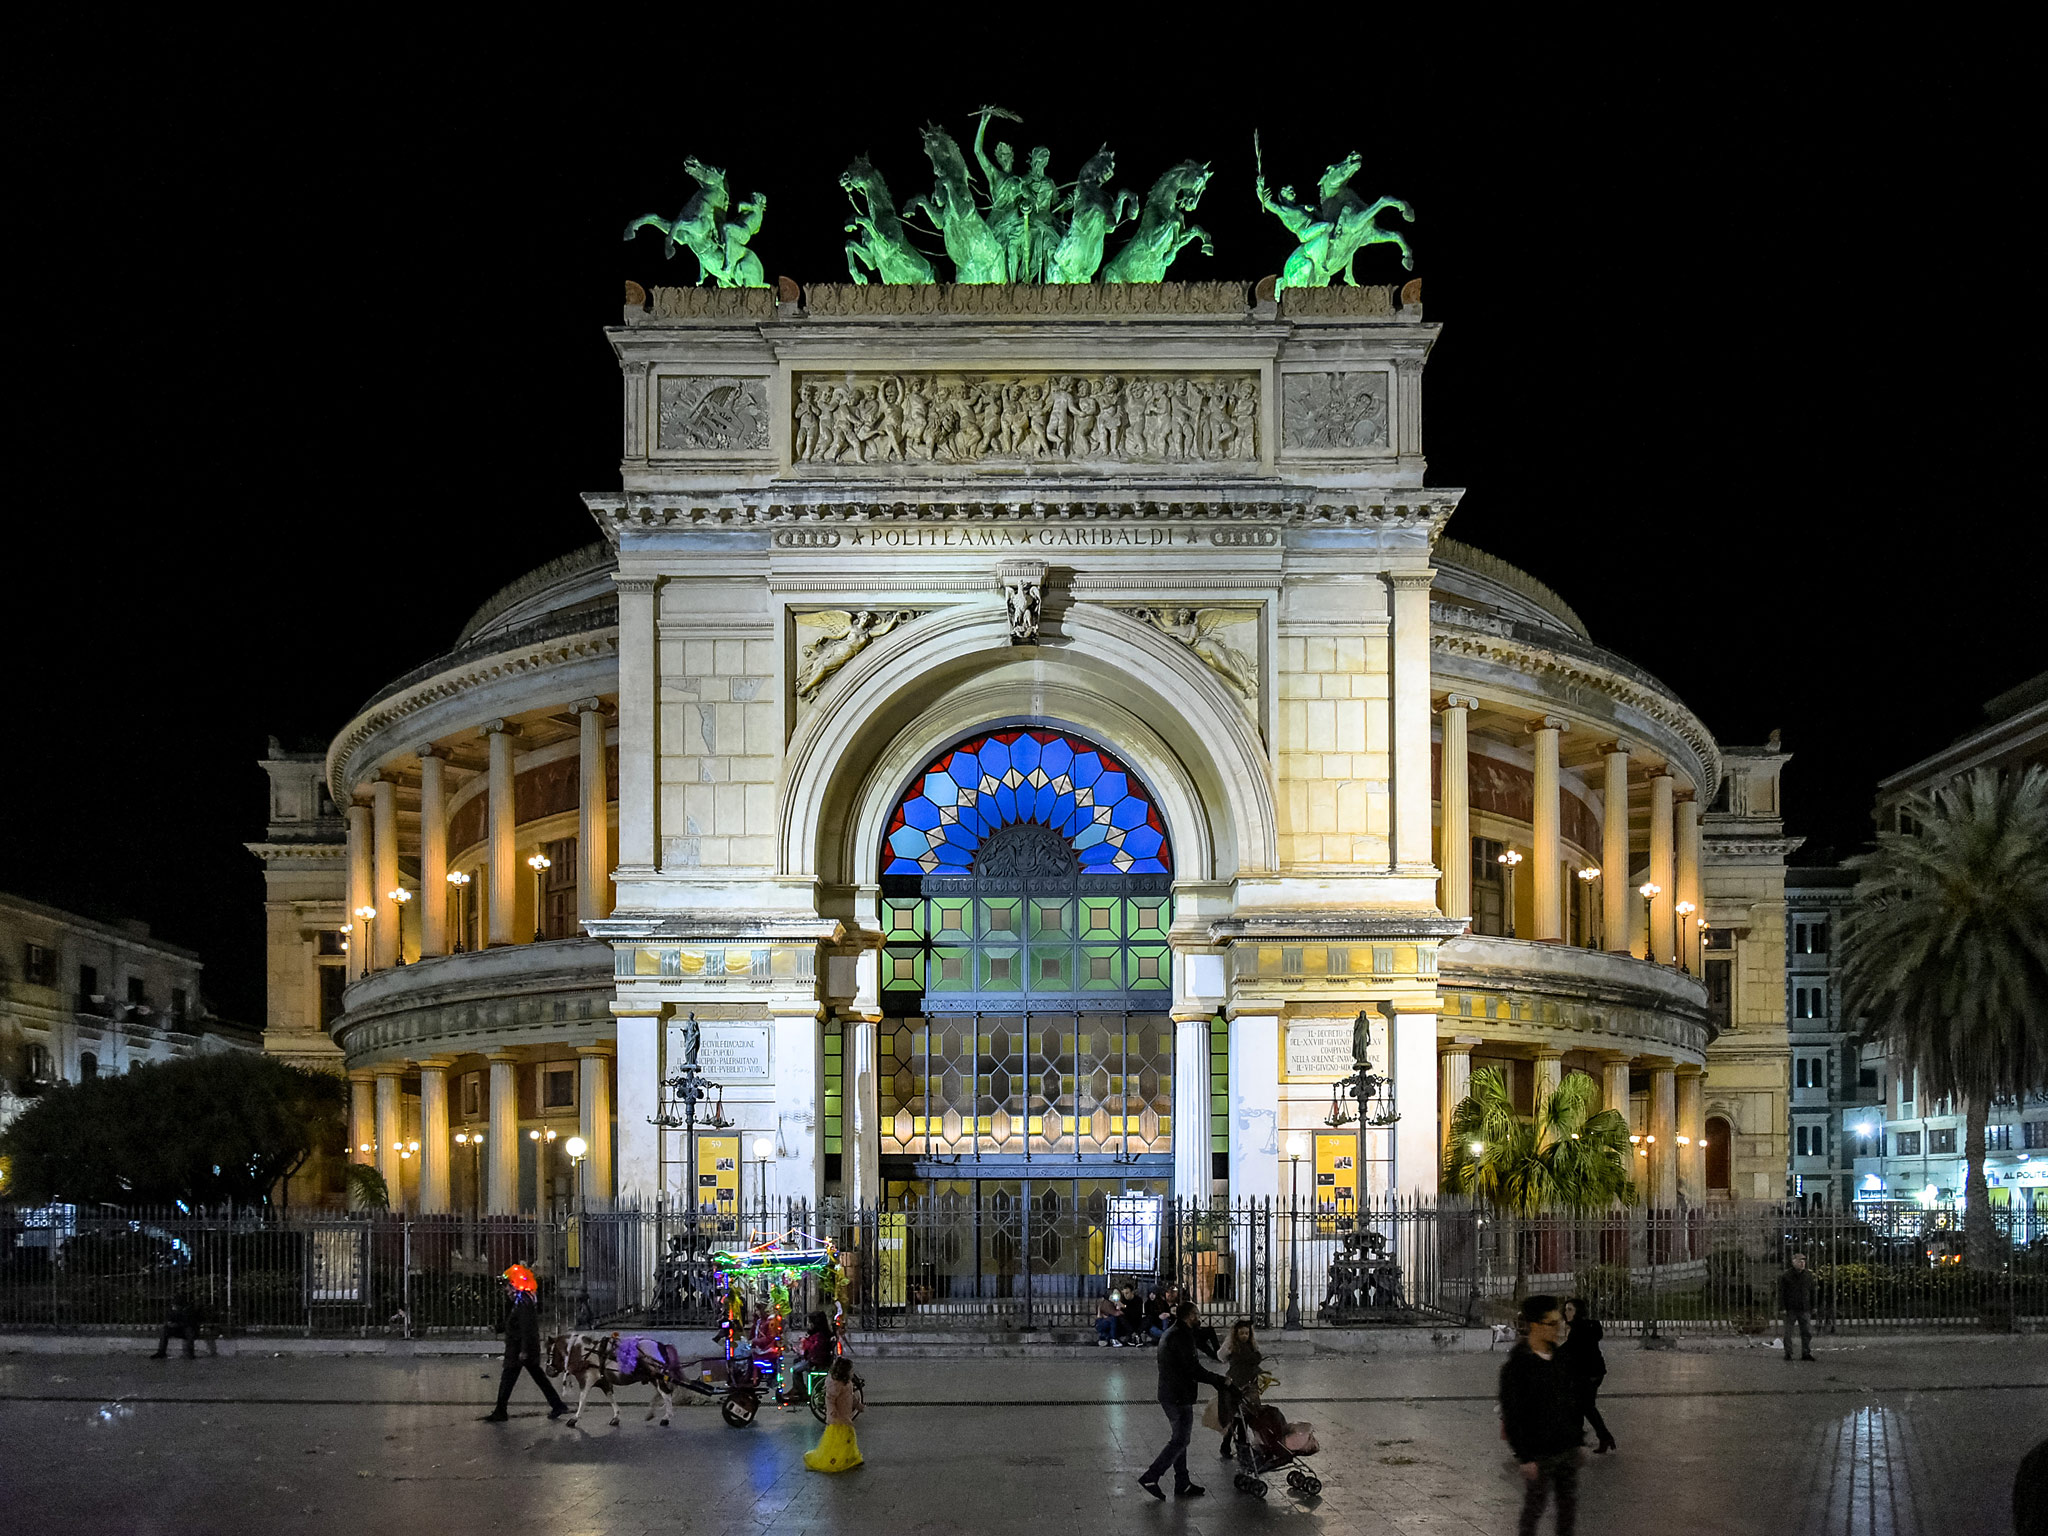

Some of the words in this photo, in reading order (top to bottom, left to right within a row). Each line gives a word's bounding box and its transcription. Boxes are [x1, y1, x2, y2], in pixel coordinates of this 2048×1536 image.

[870, 528, 1015, 547] POLITEAMA
[1038, 527, 1174, 547] GARIBALDI
[711, 1140, 722, 1149] 59
[1328, 1138, 1340, 1147] 59
[2003, 1171, 2016, 1180] AL
